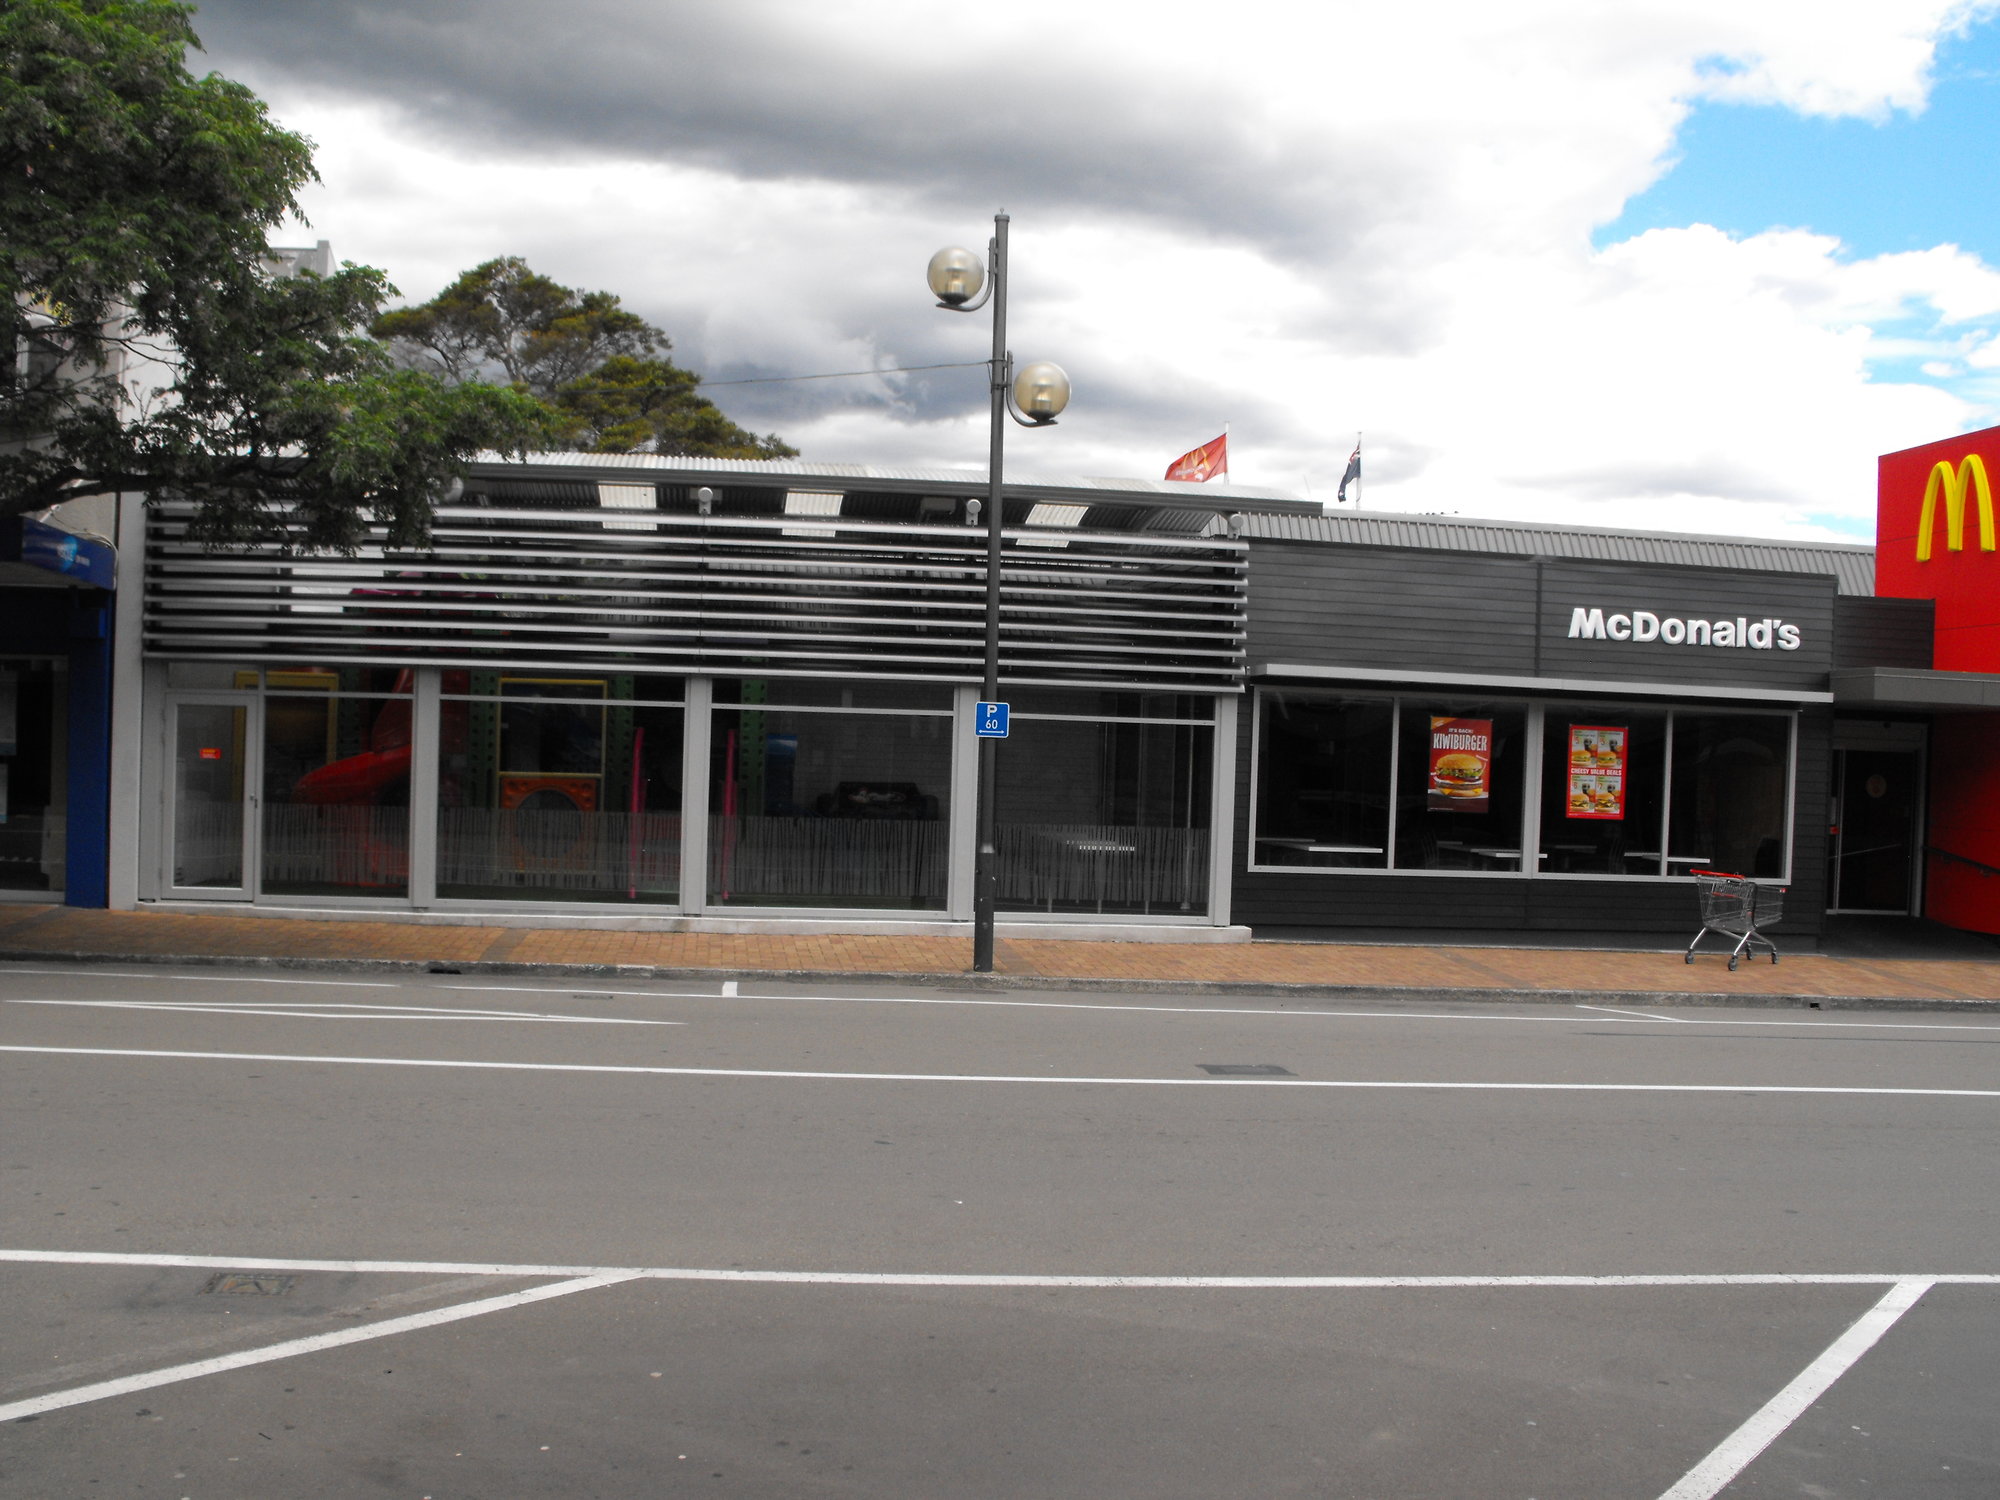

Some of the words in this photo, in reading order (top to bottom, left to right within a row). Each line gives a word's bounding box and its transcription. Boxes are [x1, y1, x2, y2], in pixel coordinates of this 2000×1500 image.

[1567, 607, 1801, 651] McDonald's
[986, 704, 998, 718] P
[985, 719, 998, 730] 60
[1433, 733, 1488, 751] KIWIBURGER
